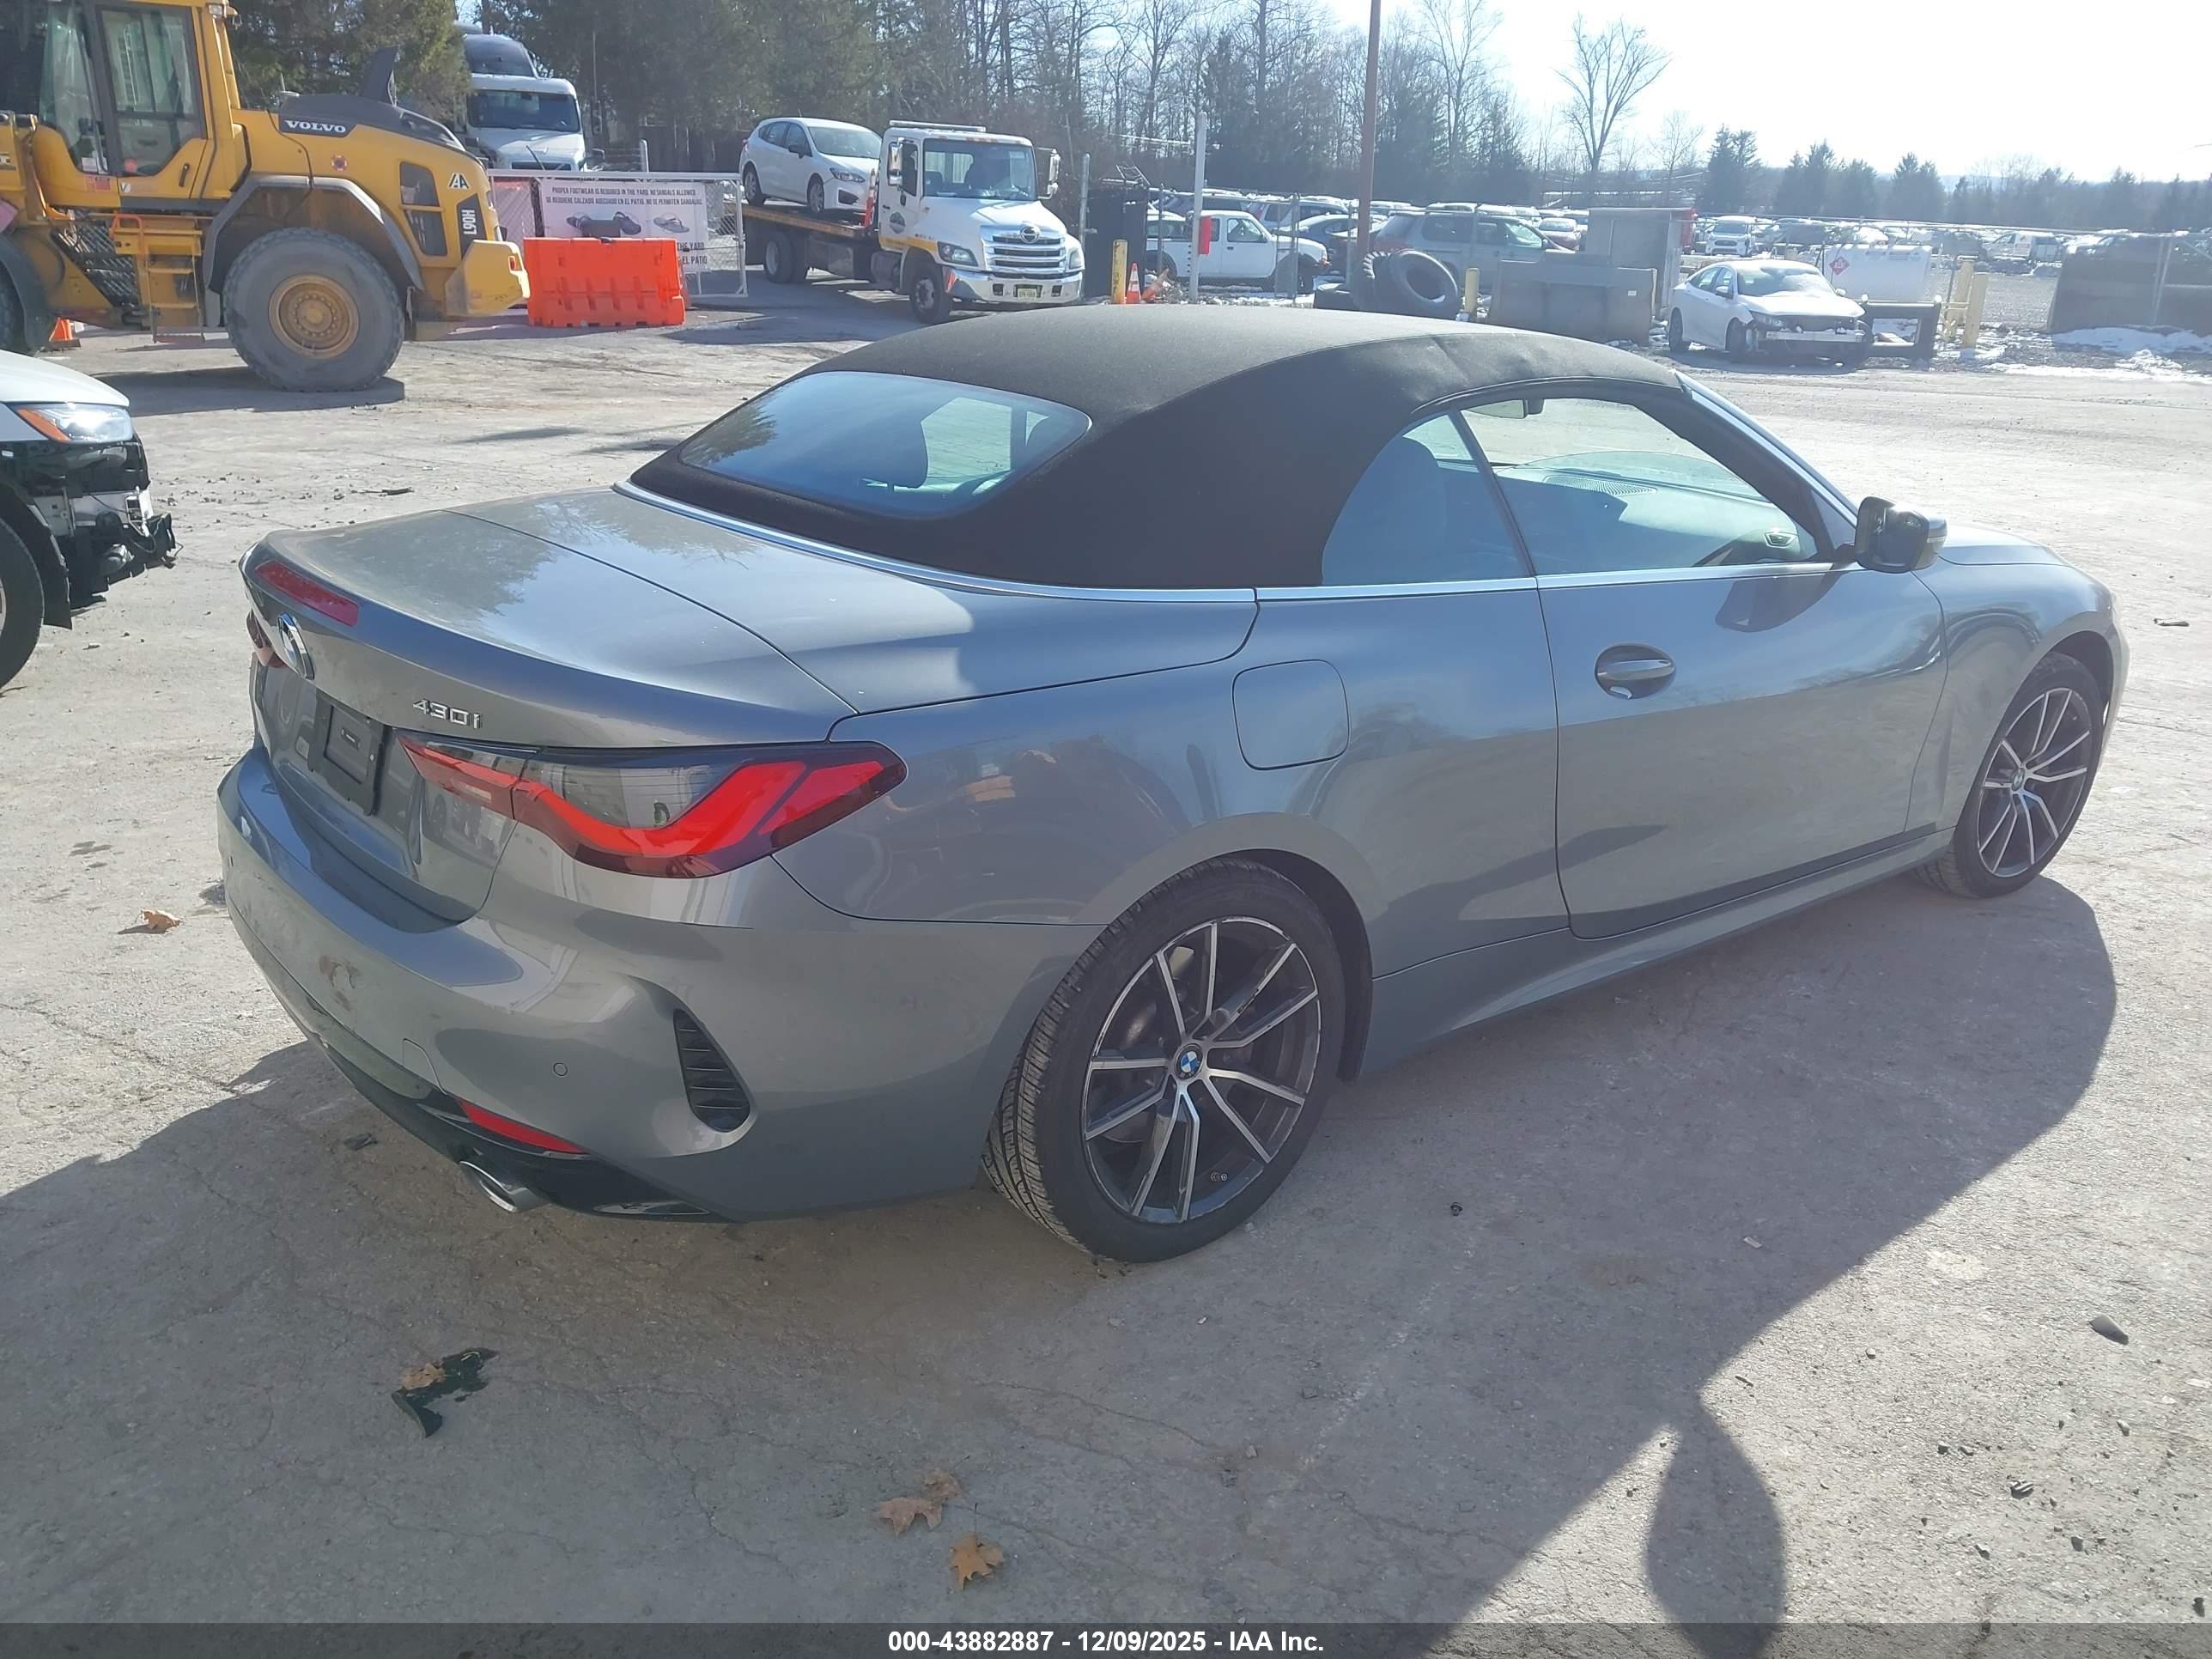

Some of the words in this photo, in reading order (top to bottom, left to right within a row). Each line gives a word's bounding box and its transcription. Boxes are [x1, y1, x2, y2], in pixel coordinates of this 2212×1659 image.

[284, 119, 346, 133] VOLVO
[461, 209, 477, 234] L90H
[690, 255, 708, 264] PATIO
[412, 699, 481, 729] 430i
